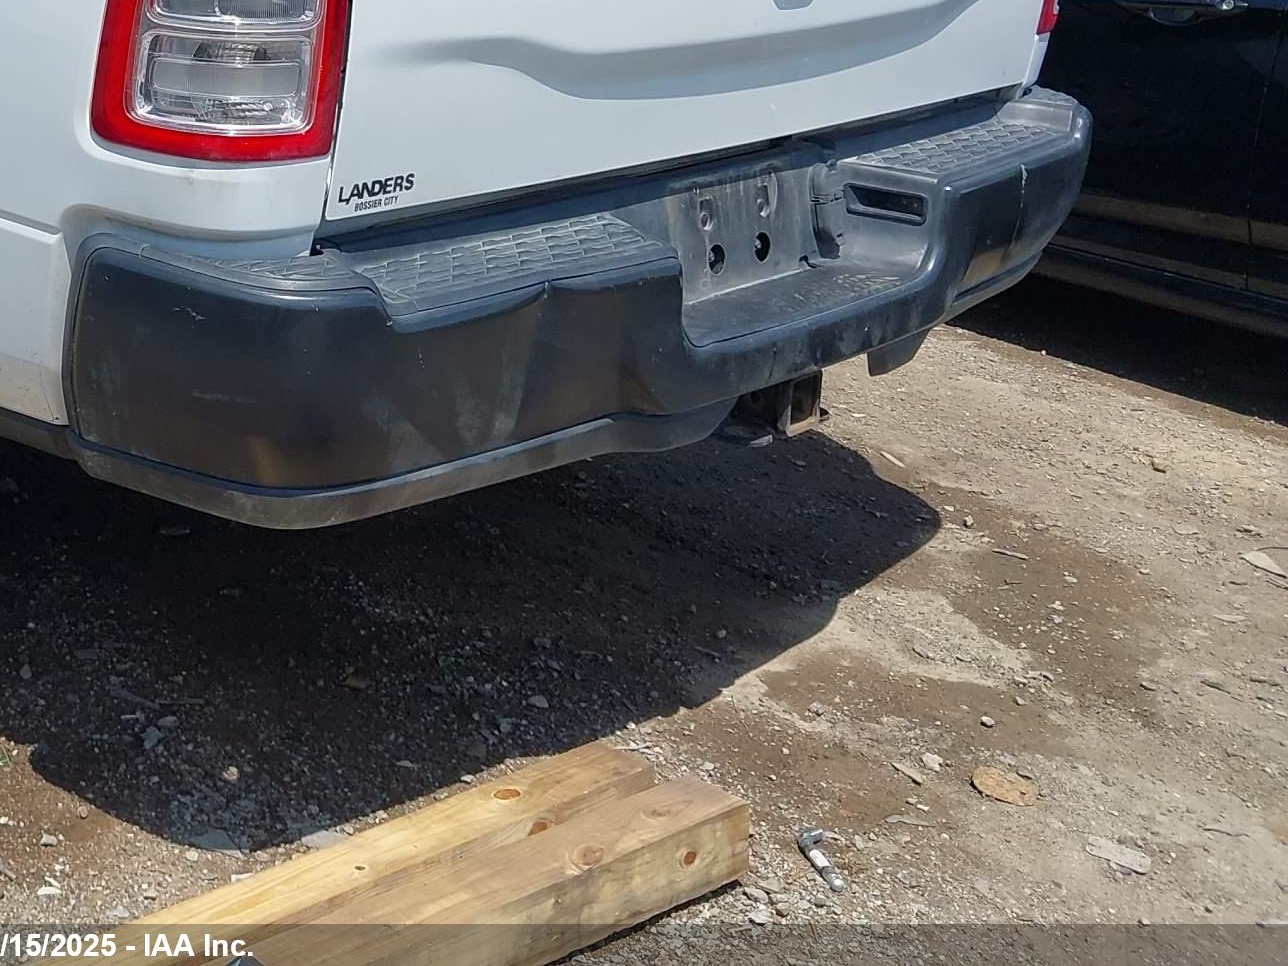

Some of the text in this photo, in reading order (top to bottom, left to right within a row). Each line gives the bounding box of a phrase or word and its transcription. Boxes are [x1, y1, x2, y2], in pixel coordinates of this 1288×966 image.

[338, 173, 415, 205] LANDERS
[354, 195, 399, 212] BOSSIER CITY
